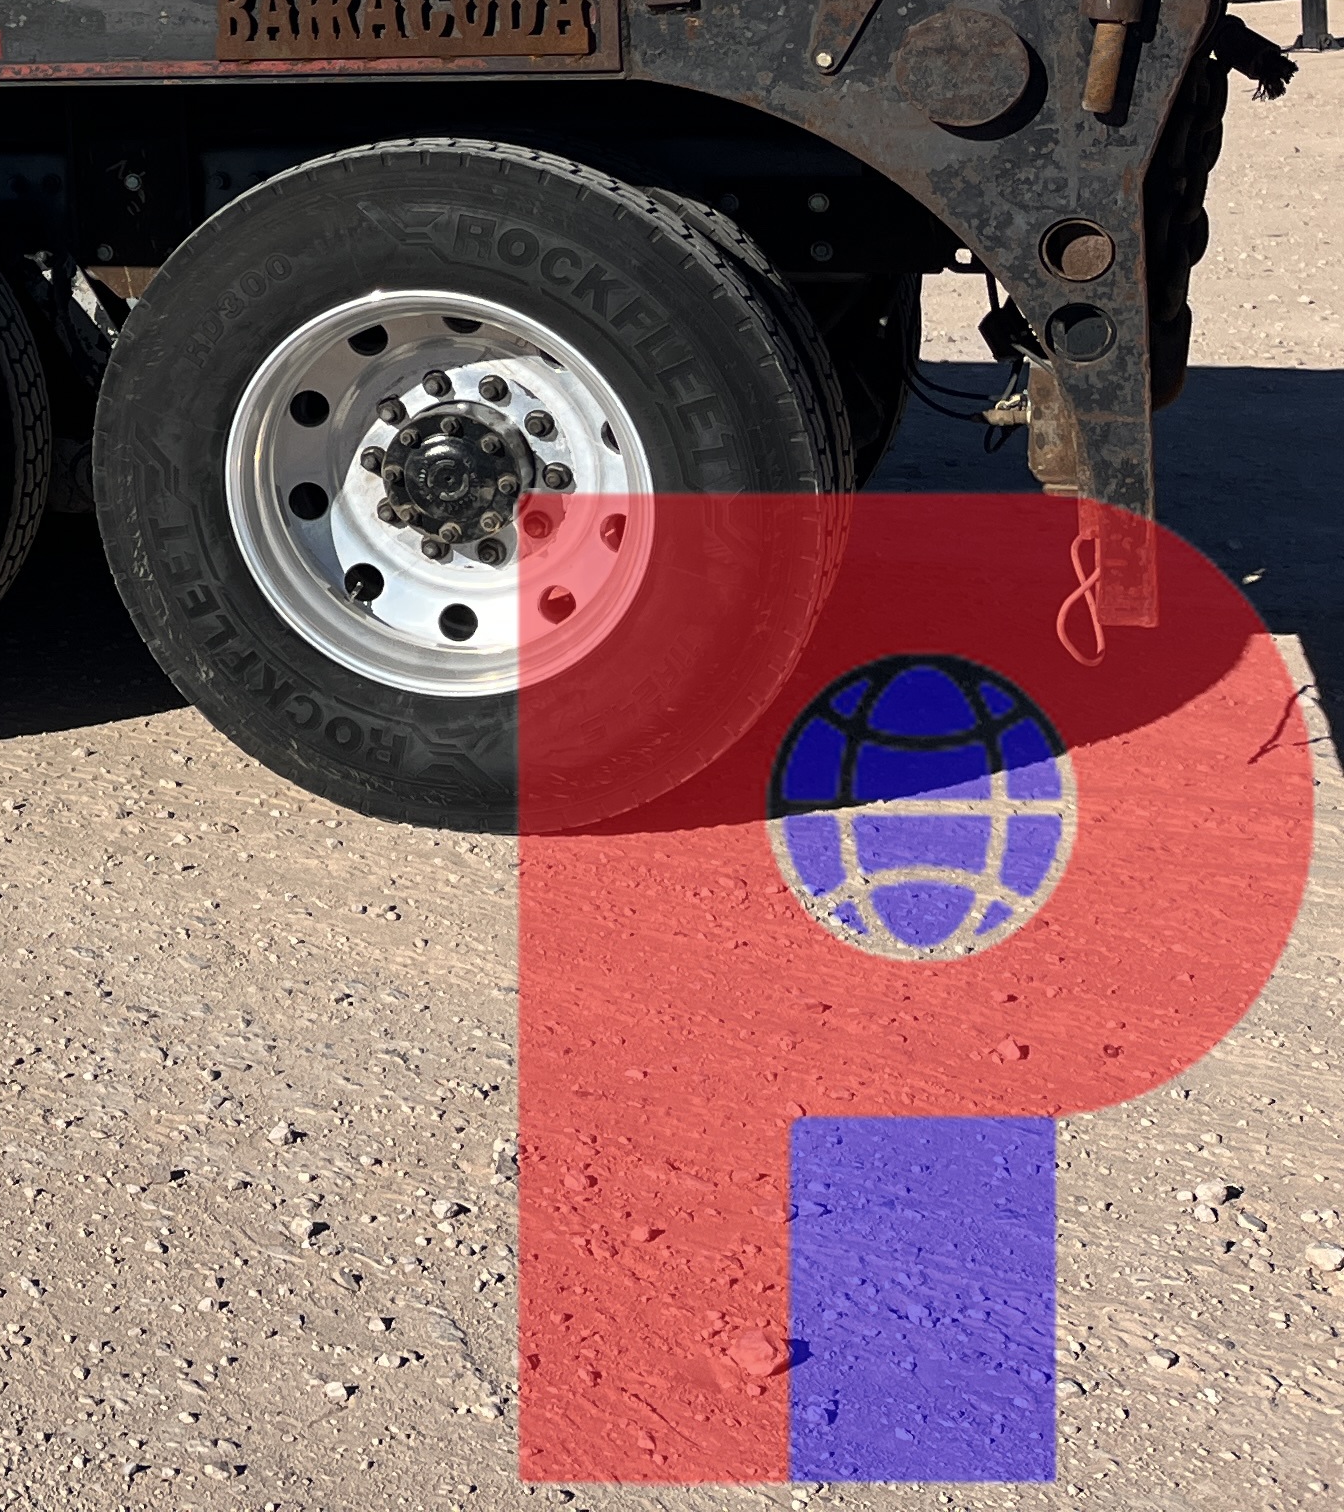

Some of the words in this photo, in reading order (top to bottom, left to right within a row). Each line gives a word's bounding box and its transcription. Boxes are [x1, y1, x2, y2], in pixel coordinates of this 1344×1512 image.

[182, 253, 293, 369] RD300
[452, 212, 738, 482] ROCKFLEET
[149, 514, 407, 773] ROCKFLEET
